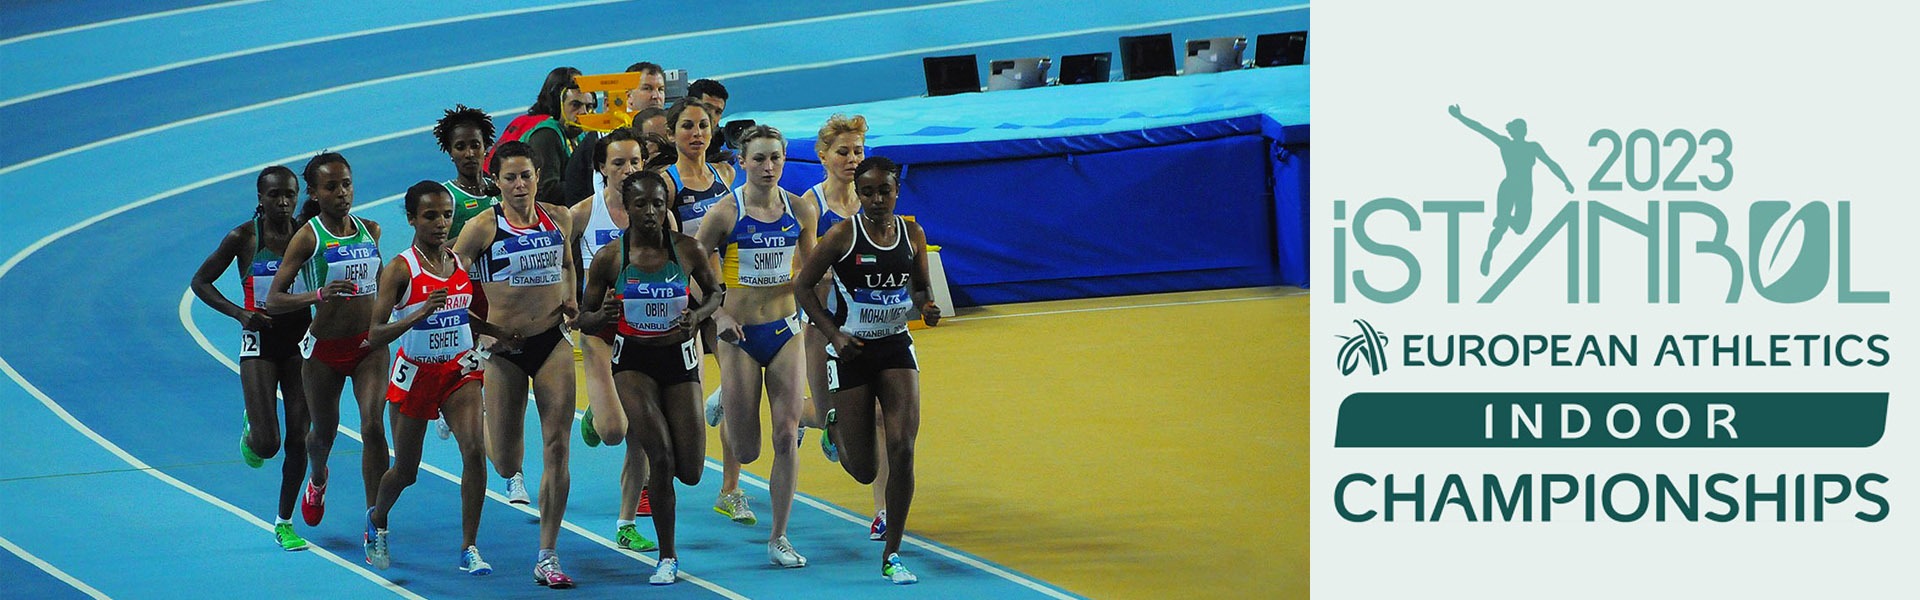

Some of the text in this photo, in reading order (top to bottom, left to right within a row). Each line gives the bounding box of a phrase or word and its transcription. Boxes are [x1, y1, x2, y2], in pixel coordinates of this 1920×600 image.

[530, 236, 552, 248] VTB
[764, 236, 786, 247] VTB
[350, 247, 370, 259] VTB
[754, 252, 784, 270] SHMIDT
[345, 263, 368, 280] DEFAR
[512, 275, 550, 285] ISTANBUL
[738, 275, 777, 285] ISTANBUL
[651, 287, 674, 298] VTB
[446, 296, 469, 311] RAIN
[645, 302, 668, 318] OBIRI
[440, 315, 461, 328] VTB
[628, 321, 668, 330] STANBUL
[242, 333, 258, 352] 12
[429, 329, 459, 350] ESHETE
[467, 354, 479, 371] 5
[396, 363, 409, 384] 5
